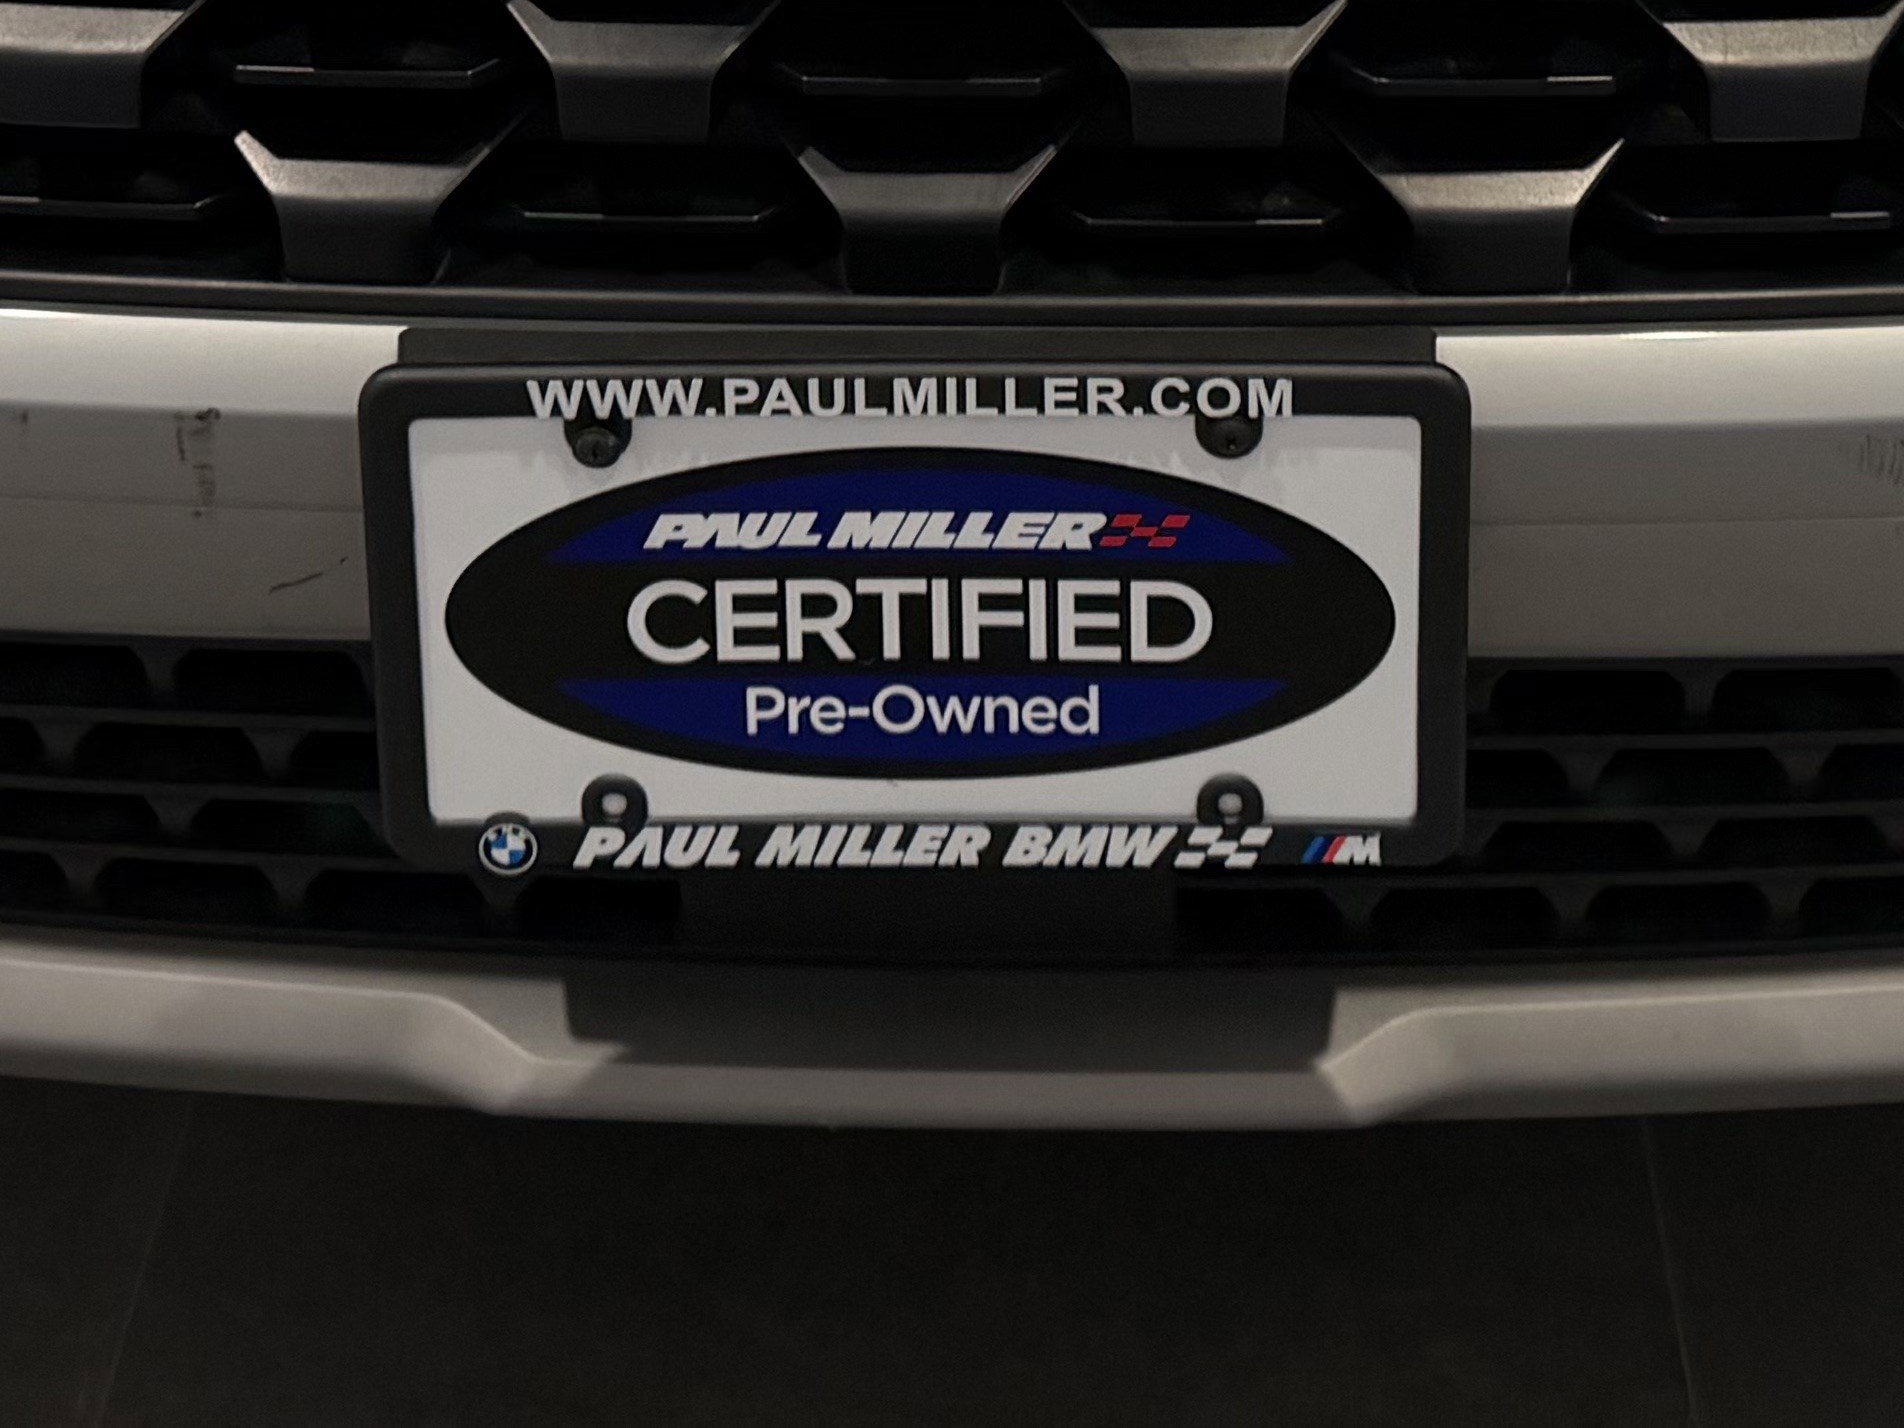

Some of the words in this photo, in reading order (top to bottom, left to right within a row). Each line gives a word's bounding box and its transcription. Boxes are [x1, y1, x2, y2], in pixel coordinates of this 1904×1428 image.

[526, 377, 1295, 419] WWW.PAULMILLER.COM
[642, 512, 821, 549] PAUL
[826, 511, 1107, 550] MILLER
[626, 577, 1214, 664] CERTIFIED
[745, 684, 1100, 735] Pre-Owned
[572, 824, 741, 867] PAUL
[754, 824, 992, 867] MILLER
[1001, 824, 1180, 867] BMW
